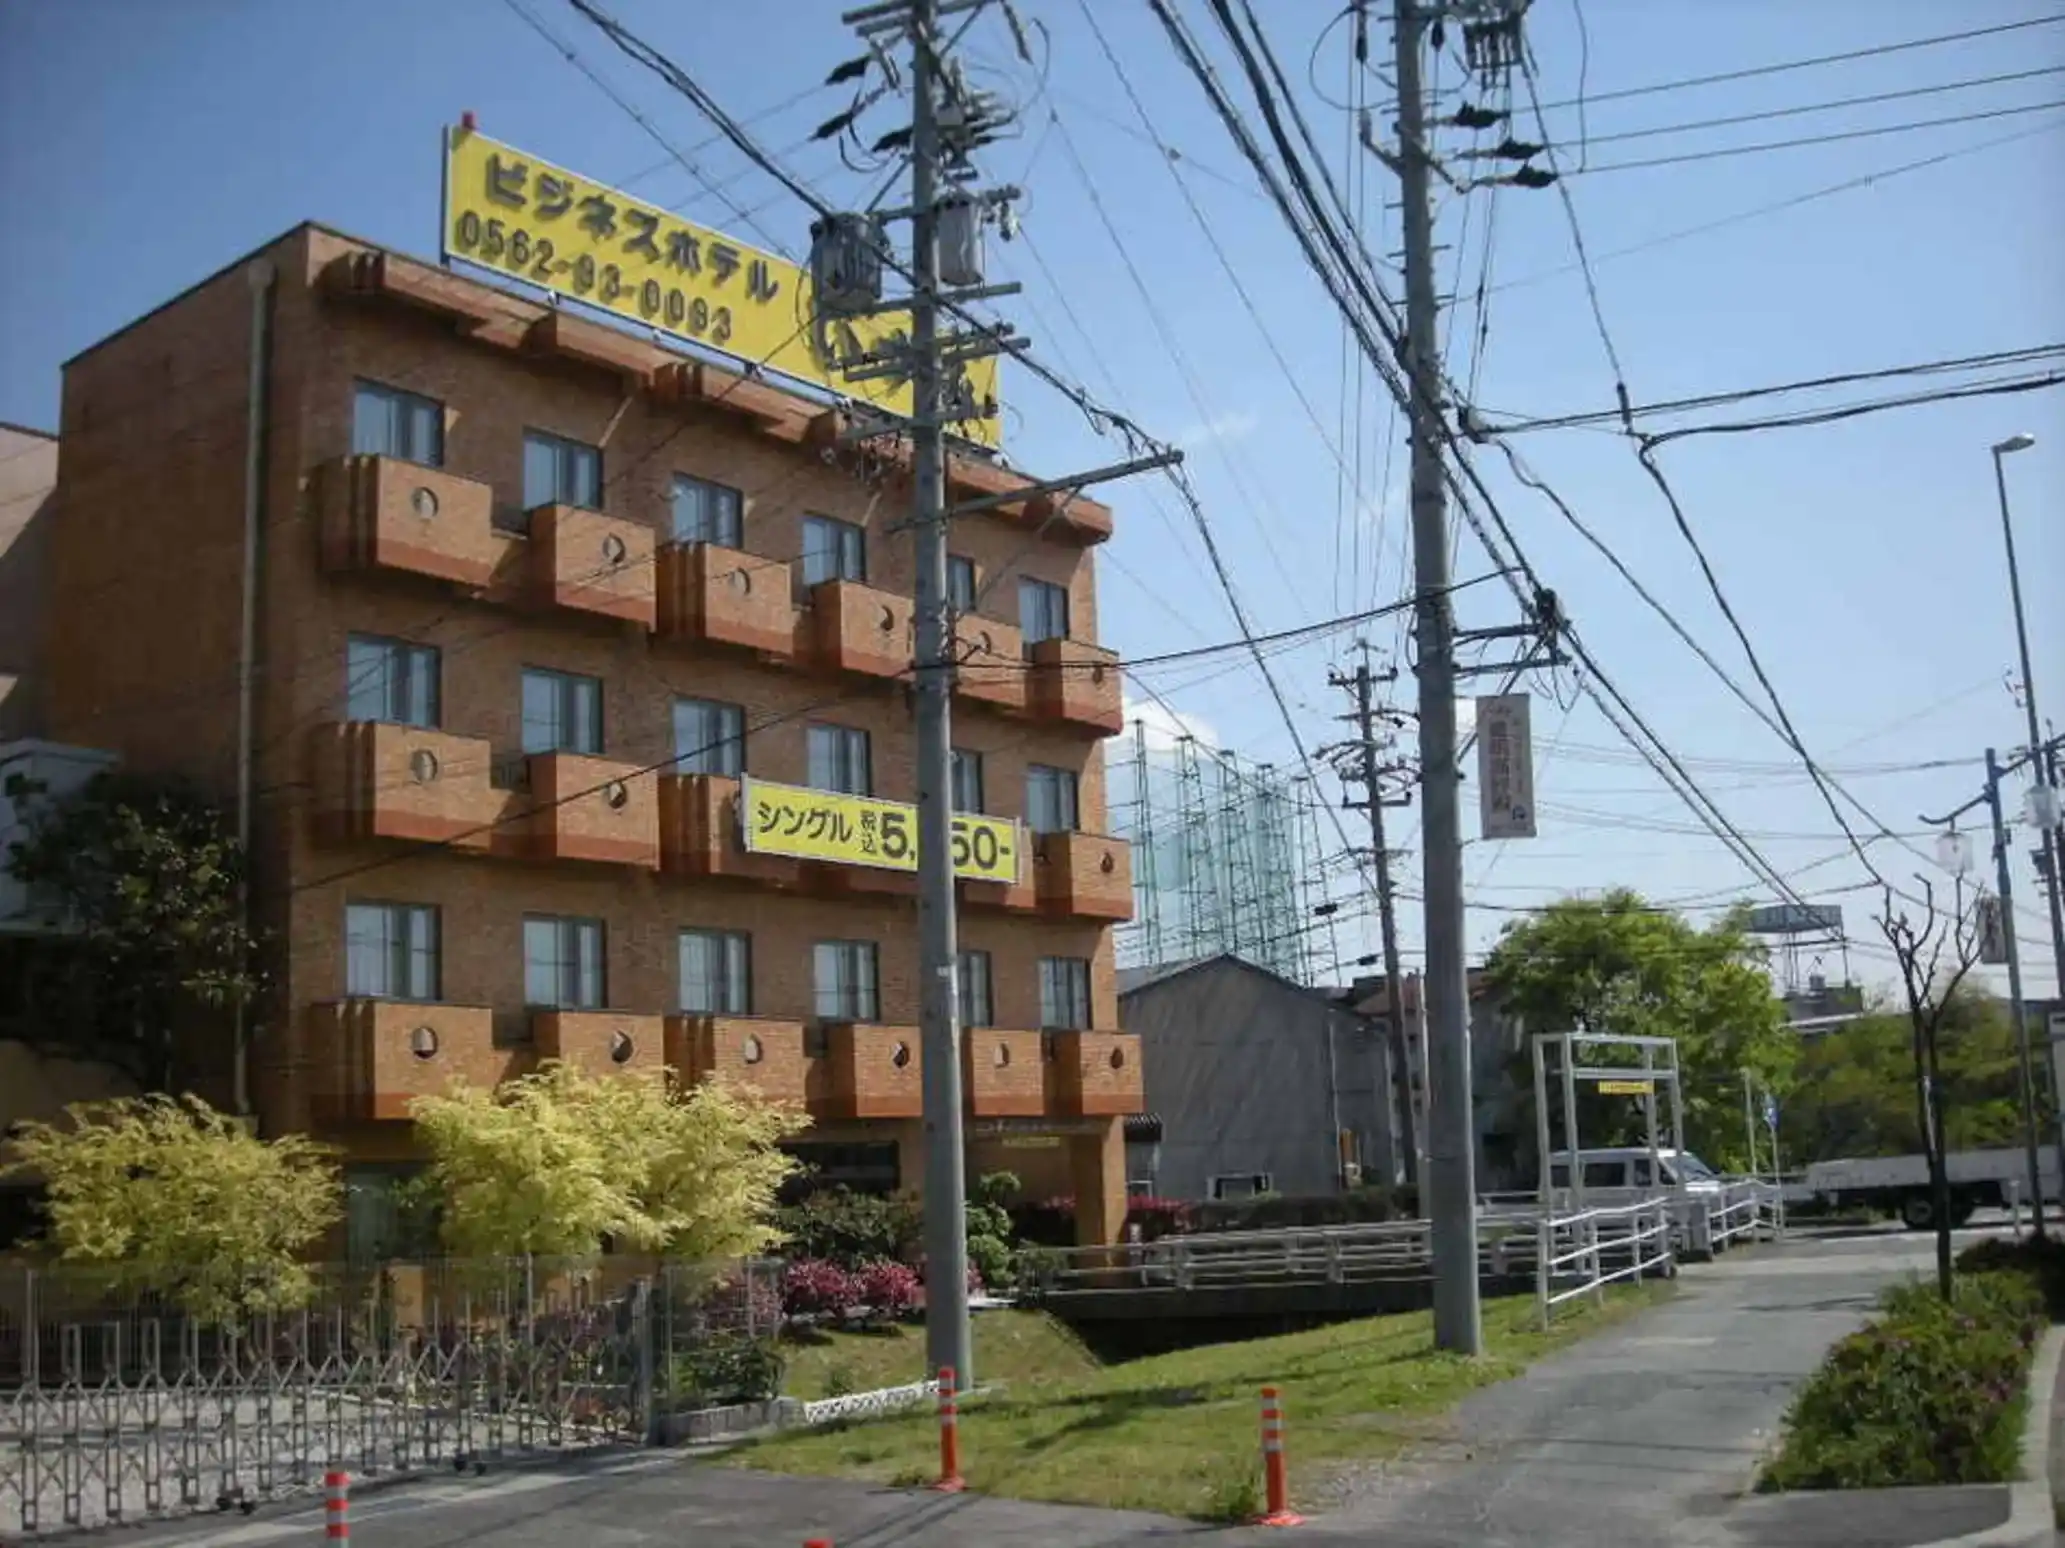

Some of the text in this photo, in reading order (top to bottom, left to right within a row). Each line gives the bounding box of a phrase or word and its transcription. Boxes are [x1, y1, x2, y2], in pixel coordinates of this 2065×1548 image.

[485, 152, 780, 304] ビジネスホテル
[757, 801, 852, 843] シングル
[881, 811, 1011, 870] 5,50-
